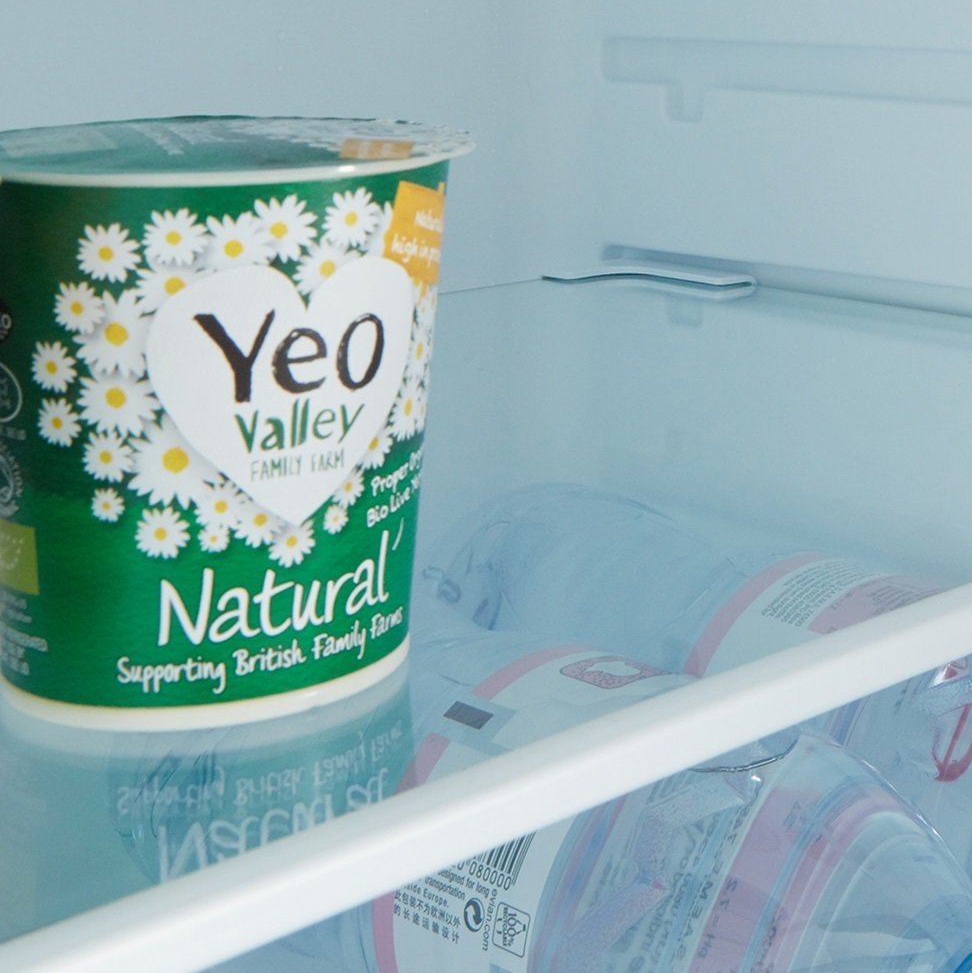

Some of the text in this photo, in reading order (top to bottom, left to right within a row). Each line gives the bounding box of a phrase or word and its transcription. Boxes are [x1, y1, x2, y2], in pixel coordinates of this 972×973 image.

[194, 309, 386, 403] Yeo
[234, 398, 366, 453] Valley
[250, 449, 345, 482] FAMILY FARM
[371, 462, 409, 496] Proper
[367, 487, 411, 528] Bio Live
[157, 530, 390, 647] Natural
[117, 606, 403, 695] Supporting British Family Farms
[438, 868, 466, 886] esigned
[468, 861, 512, 891] 080000
[481, 888, 498, 951] evian.com
